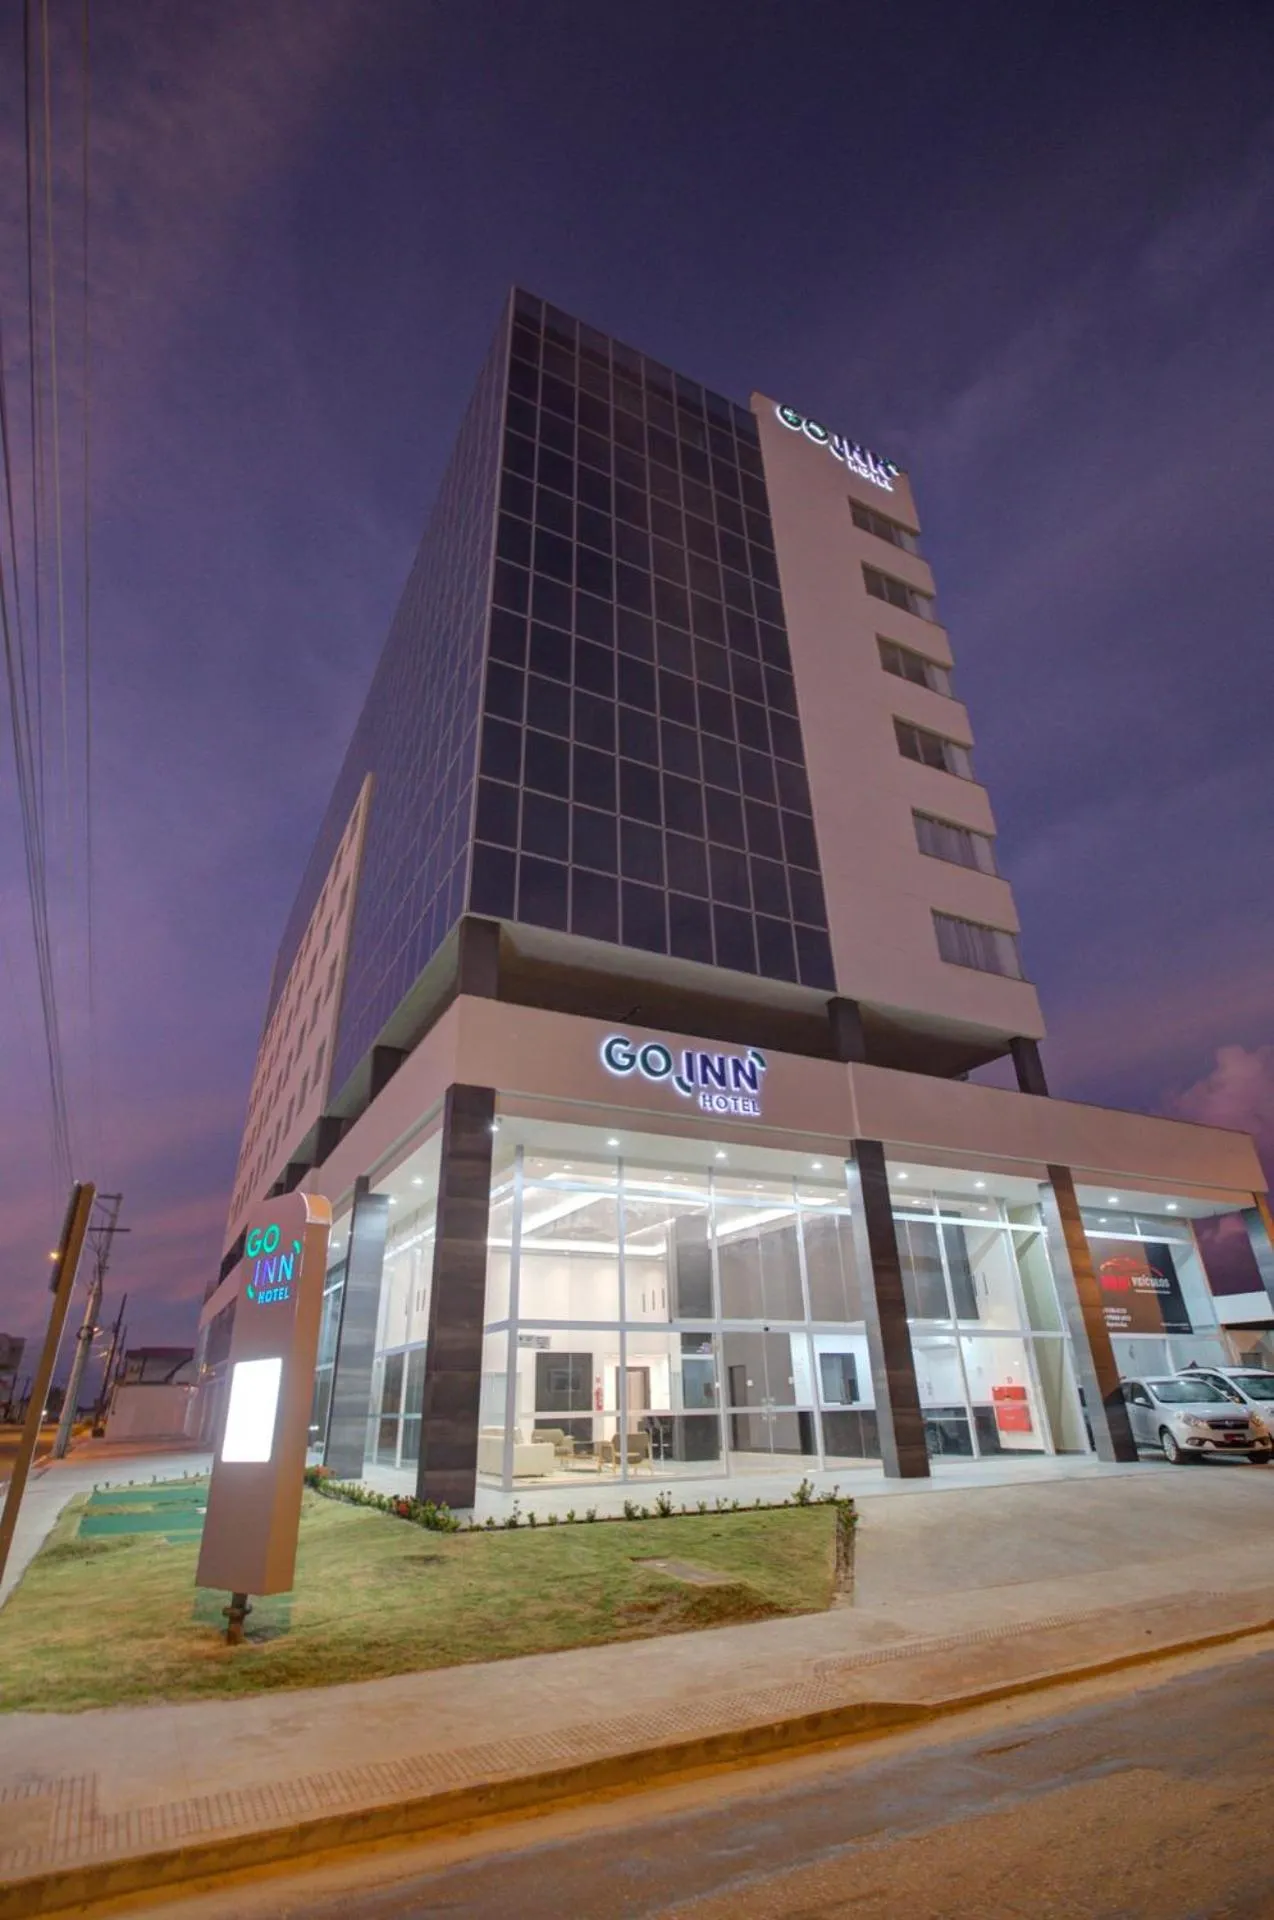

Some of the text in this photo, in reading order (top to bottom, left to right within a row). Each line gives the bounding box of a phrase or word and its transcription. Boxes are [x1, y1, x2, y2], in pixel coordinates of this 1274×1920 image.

[776, 404, 828, 444] GO
[602, 1036, 760, 1093] GO INN
[700, 1092, 760, 1116] HOTEL
[246, 1223, 280, 1258] GO
[253, 1252, 294, 1287] INN
[257, 1286, 289, 1304] HOTEL
